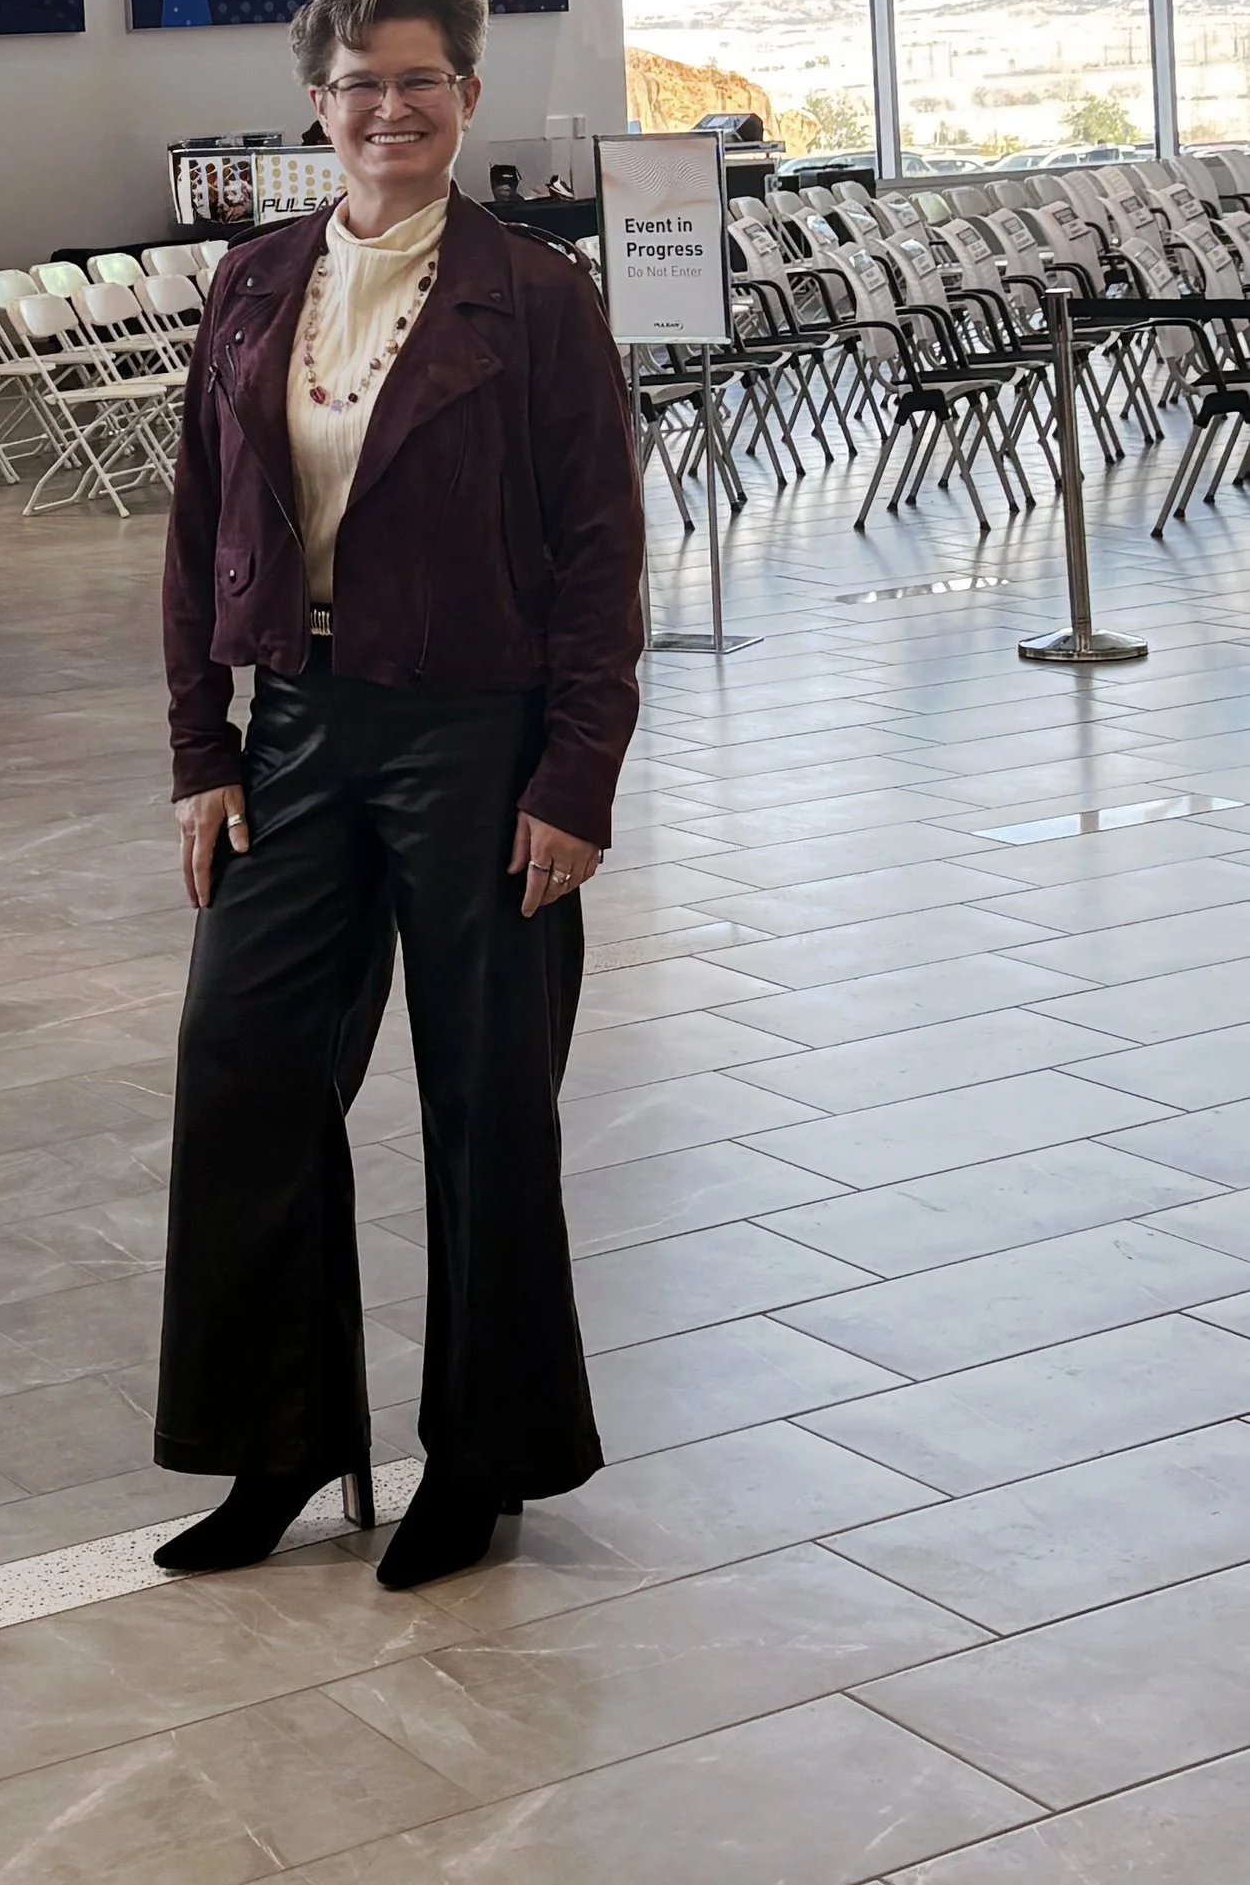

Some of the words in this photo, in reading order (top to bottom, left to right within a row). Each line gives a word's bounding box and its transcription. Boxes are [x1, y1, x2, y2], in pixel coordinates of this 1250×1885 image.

[261, 196, 337, 213] PULSA
[625, 218, 673, 233] Event
[677, 217, 693, 233] in
[626, 242, 704, 260] Progress
[627, 265, 644, 278] Do
[646, 265, 667, 277] Not
[671, 264, 703, 277] Enter
